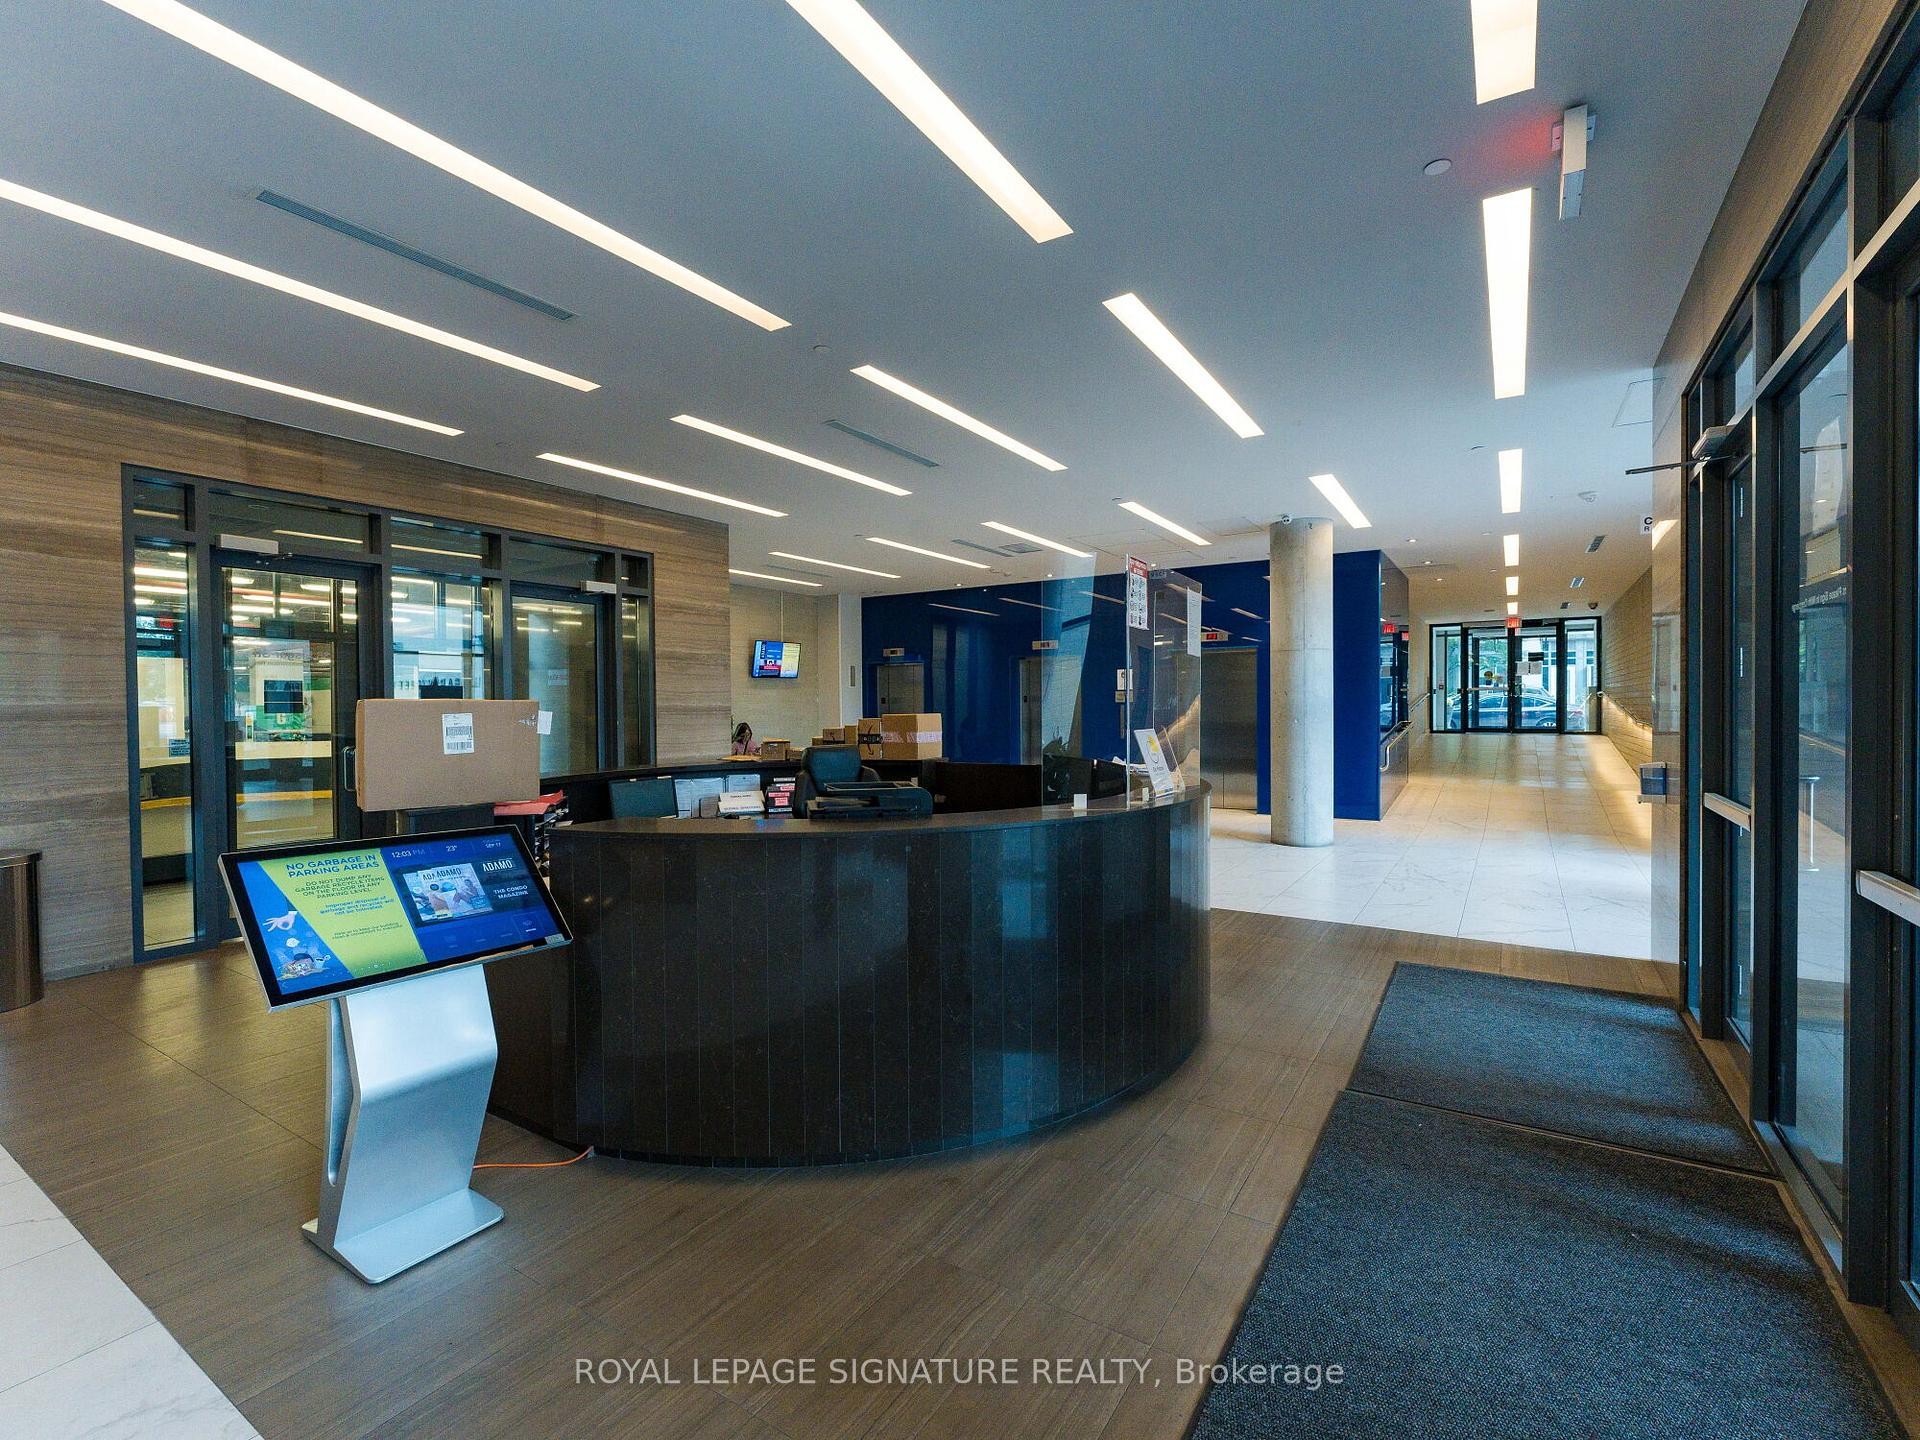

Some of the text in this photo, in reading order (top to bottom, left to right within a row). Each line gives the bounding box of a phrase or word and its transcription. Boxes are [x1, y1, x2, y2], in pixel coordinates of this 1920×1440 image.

[308, 856, 361, 868] GARBAGE
[482, 860, 513, 872] ADAMO
[288, 861, 380, 878] PARKING AREAS
[436, 868, 462, 878] ADAMO
